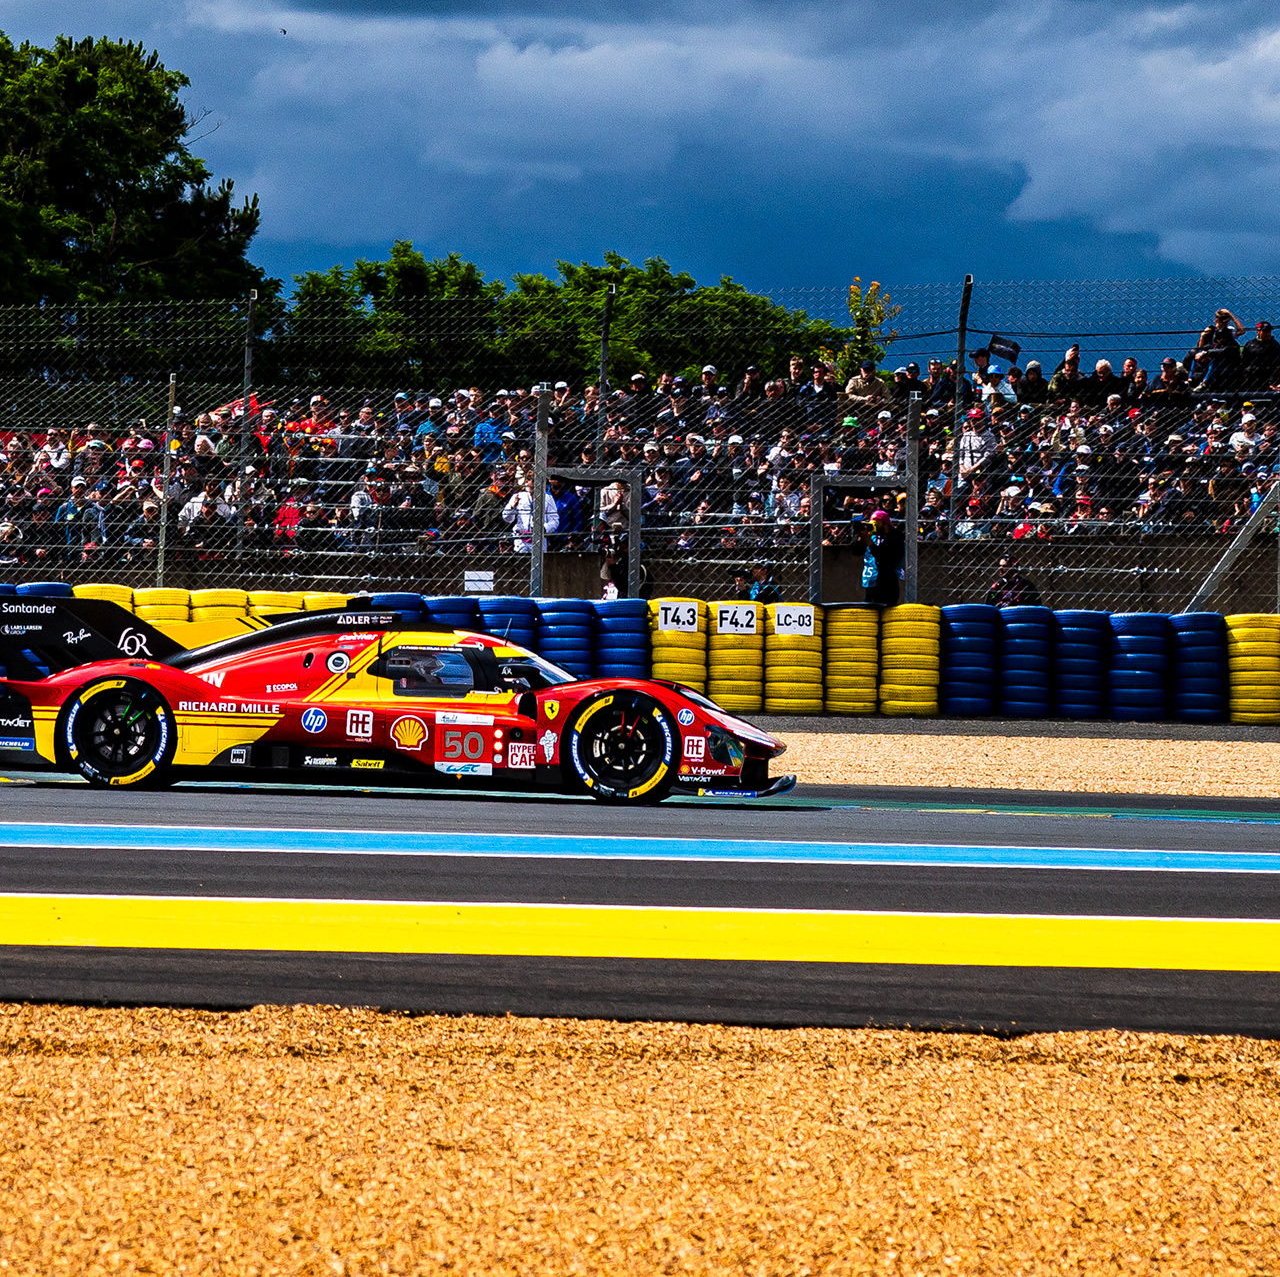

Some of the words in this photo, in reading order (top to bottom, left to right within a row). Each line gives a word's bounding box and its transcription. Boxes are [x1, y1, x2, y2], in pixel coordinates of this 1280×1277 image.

[2, 602, 56, 614] Santander
[660, 606, 696, 626] T4.3
[336, 615, 370, 624] ADLER
[719, 609, 755, 629] F4.2
[777, 613, 812, 627] LC-03
[62, 628, 92, 644] Ray-Ban
[273, 683, 298, 691] ECOPOL
[178, 701, 237, 713] RICHARD
[240, 703, 280, 714] MILLE
[67, 704, 80, 744] MICHELIN
[305, 708, 325, 732] hp
[680, 709, 693, 725] hp
[154, 722, 168, 761] MICHELIN
[444, 731, 484, 760] 50
[510, 744, 537, 754] HYPER
[661, 722, 672, 762] MICHELIN
[510, 753, 536, 766] CAR
[572, 733, 584, 775] MICHELIN
[446, 764, 480, 773] WEC
